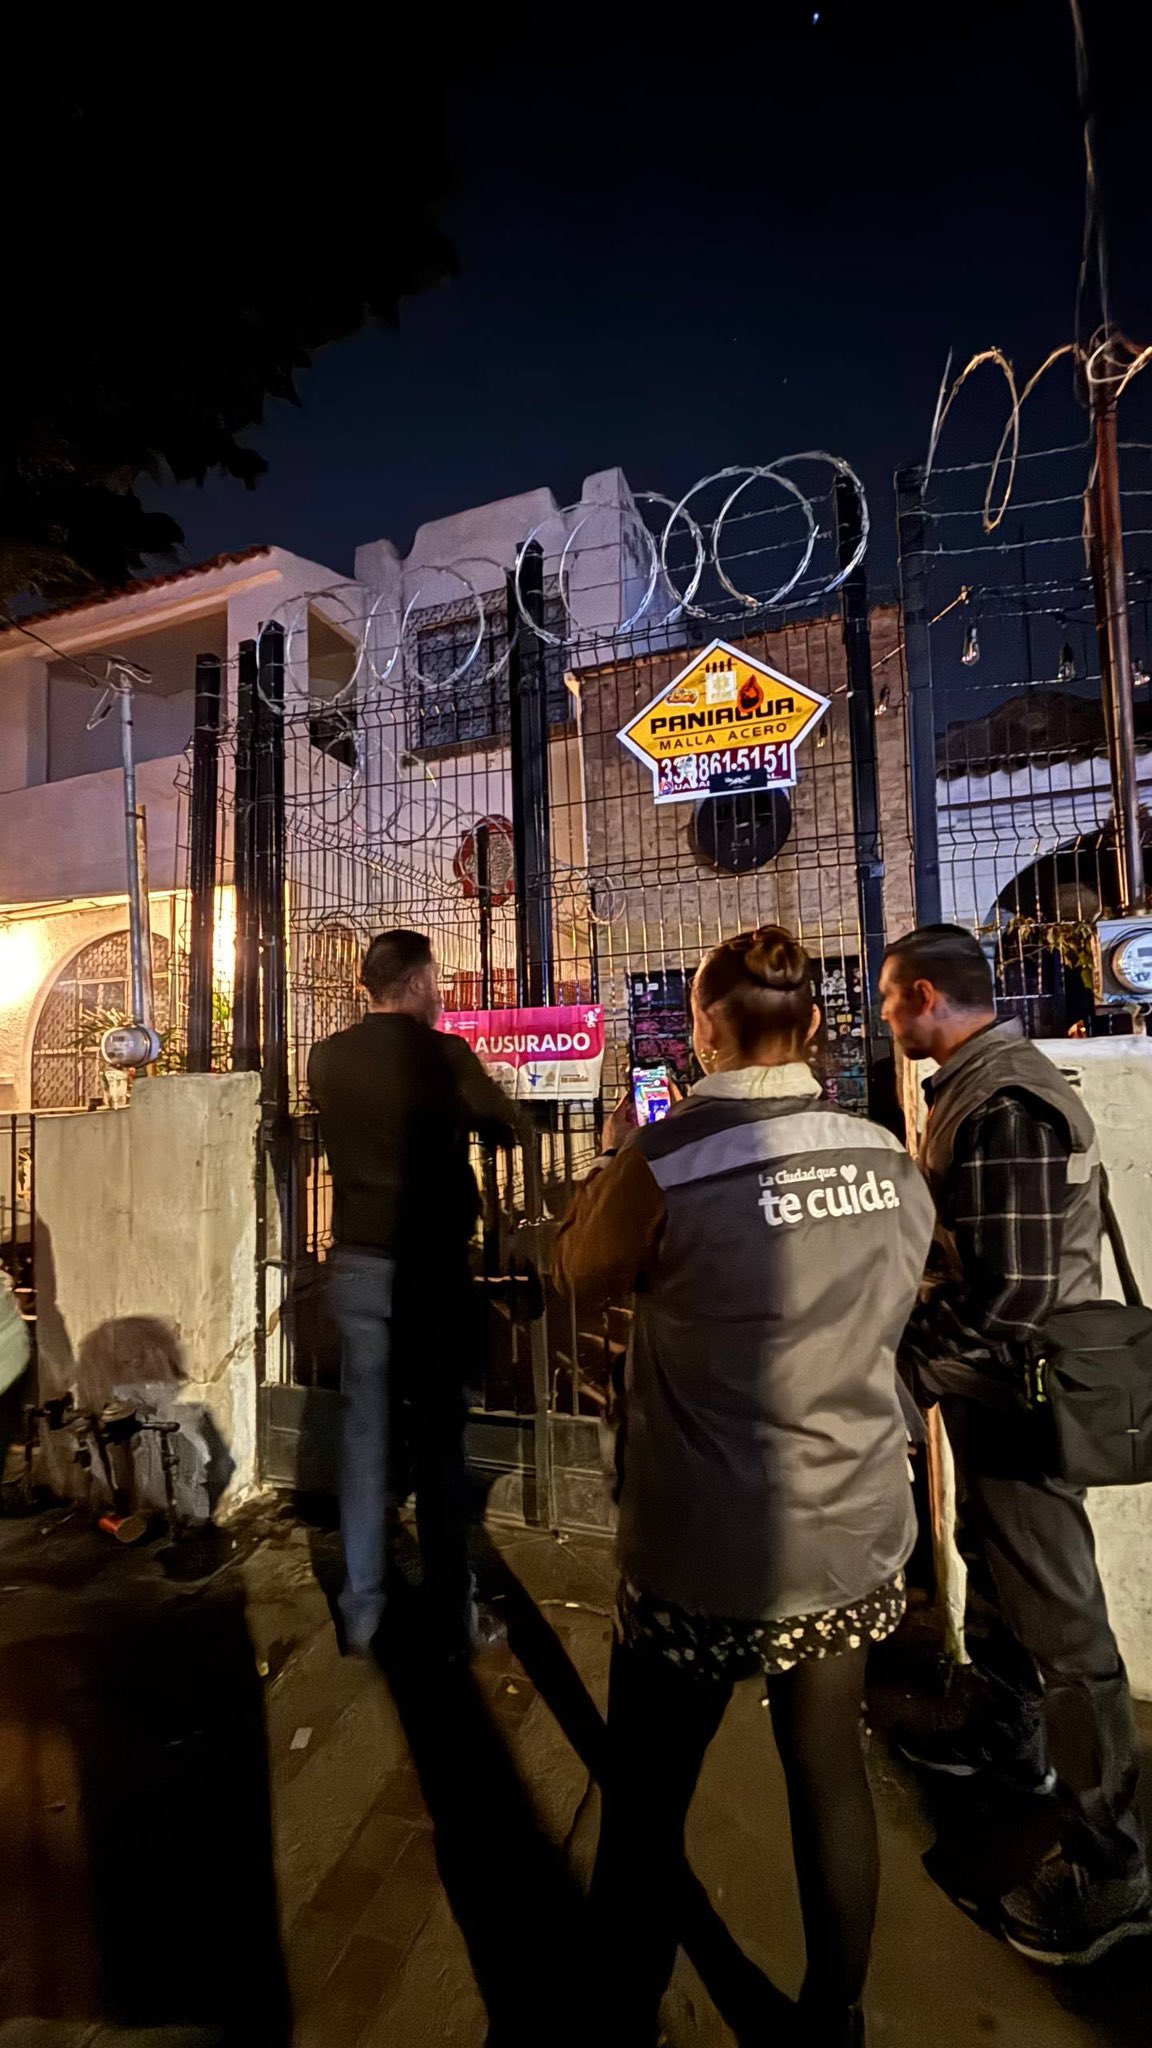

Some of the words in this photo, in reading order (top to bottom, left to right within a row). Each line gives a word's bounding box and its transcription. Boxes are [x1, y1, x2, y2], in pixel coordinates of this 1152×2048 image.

[659, 735, 716, 751] MALLA
[728, 722, 788, 741] ACERO
[758, 1173, 775, 1187] La
[775, 1166, 817, 1185] Ciudad
[816, 1167, 838, 1182] que
[758, 1189, 804, 1227] te
[806, 1170, 900, 1219] cuida
